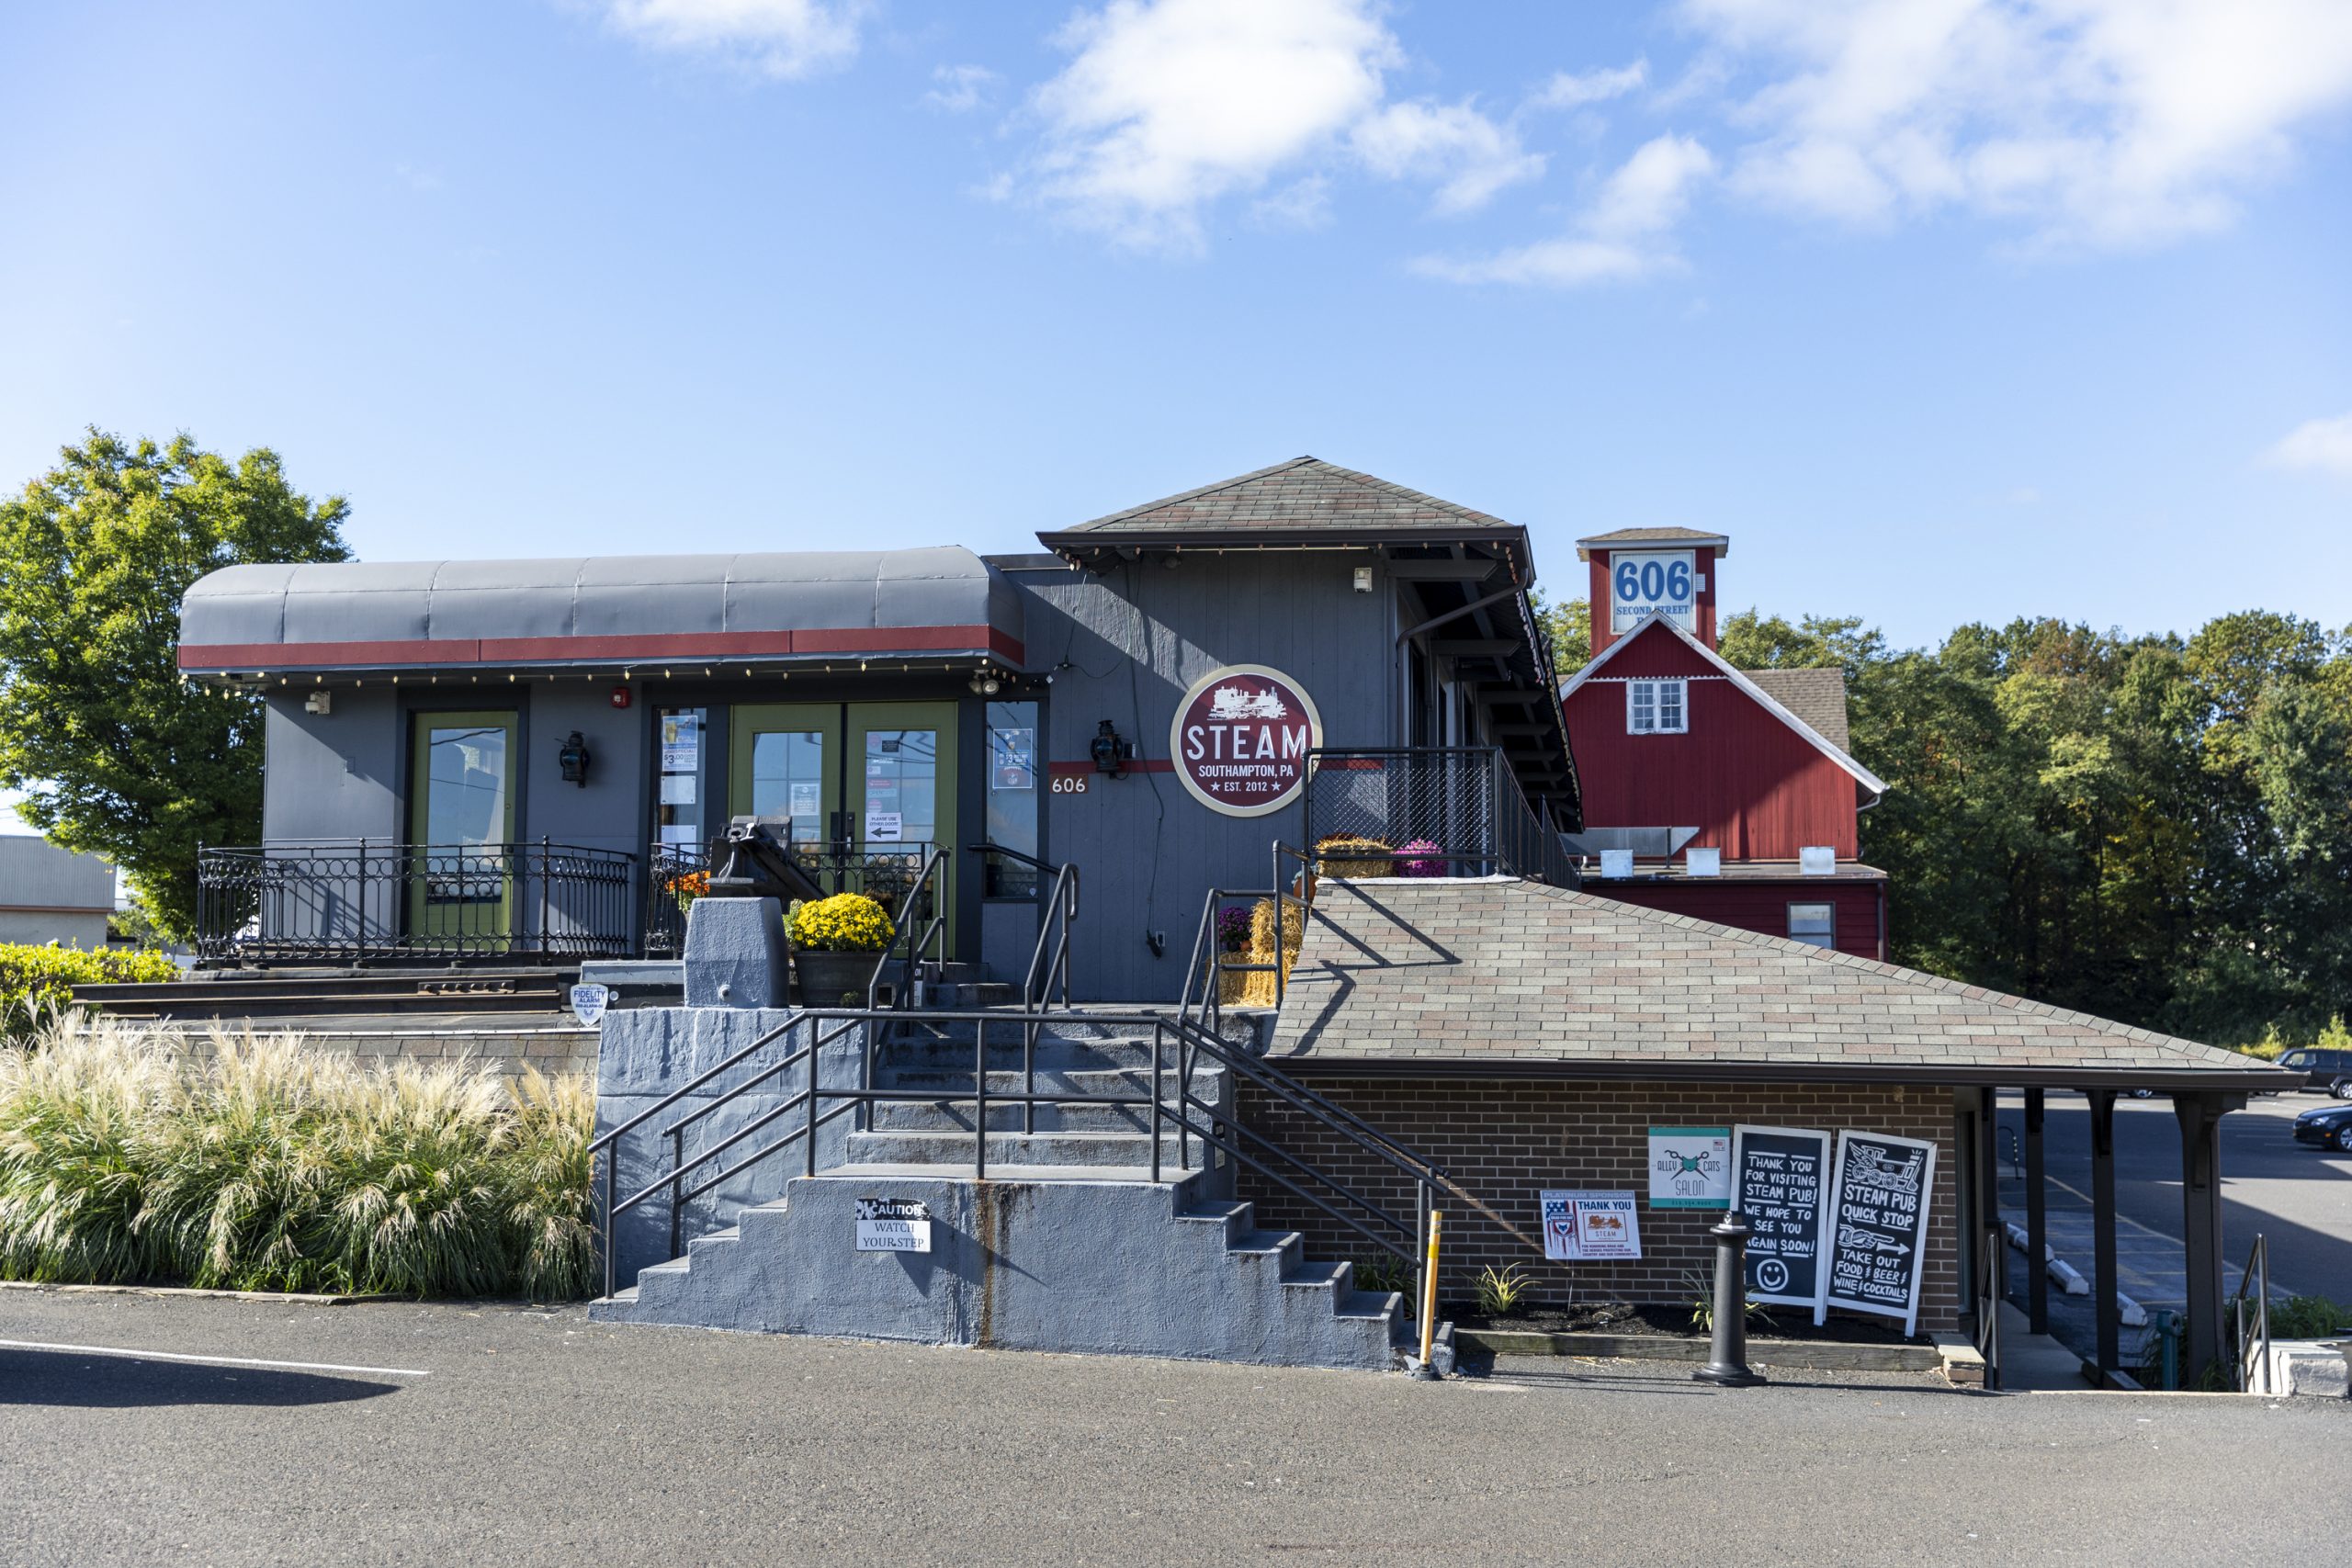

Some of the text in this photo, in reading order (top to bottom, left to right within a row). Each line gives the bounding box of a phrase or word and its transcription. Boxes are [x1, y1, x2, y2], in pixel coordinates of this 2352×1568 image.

[1616, 560, 1690, 602] 606
[1617, 606, 1651, 615] SECOND
[1187, 725, 1306, 760] STEAM
[1198, 765, 1294, 778] SOUTHAMPTON, PA
[1052, 778, 1085, 792] 606
[1224, 782, 1267, 792] EST. 2012
[1657, 1161, 1720, 1171] ALLEY CATS
[1748, 1156, 1812, 1172] THANK YOU
[1746, 1169, 1816, 1187] FOR VISITING
[1676, 1179, 1704, 1196] SALON
[1746, 1184, 1817, 1204] STEAM PUB!
[1577, 1201, 1632, 1210] THANK YOU
[1845, 1184, 1917, 1213] STEAM PUB
[1744, 1204, 1811, 1220] WE HOPE TO
[1842, 1204, 1914, 1227] QUICK STOP
[875, 1223, 914, 1233] WATCH
[1755, 1220, 1802, 1234] SEE YOU
[864, 1236, 924, 1247] YOUR STEP
[1781, 1239, 1815, 1257] SOON!
[1841, 1248, 1901, 1269] TAKE OUT
[1837, 1260, 1900, 1281] FOOD BEER
[1834, 1276, 1907, 1299] WINE COCKTAILS
